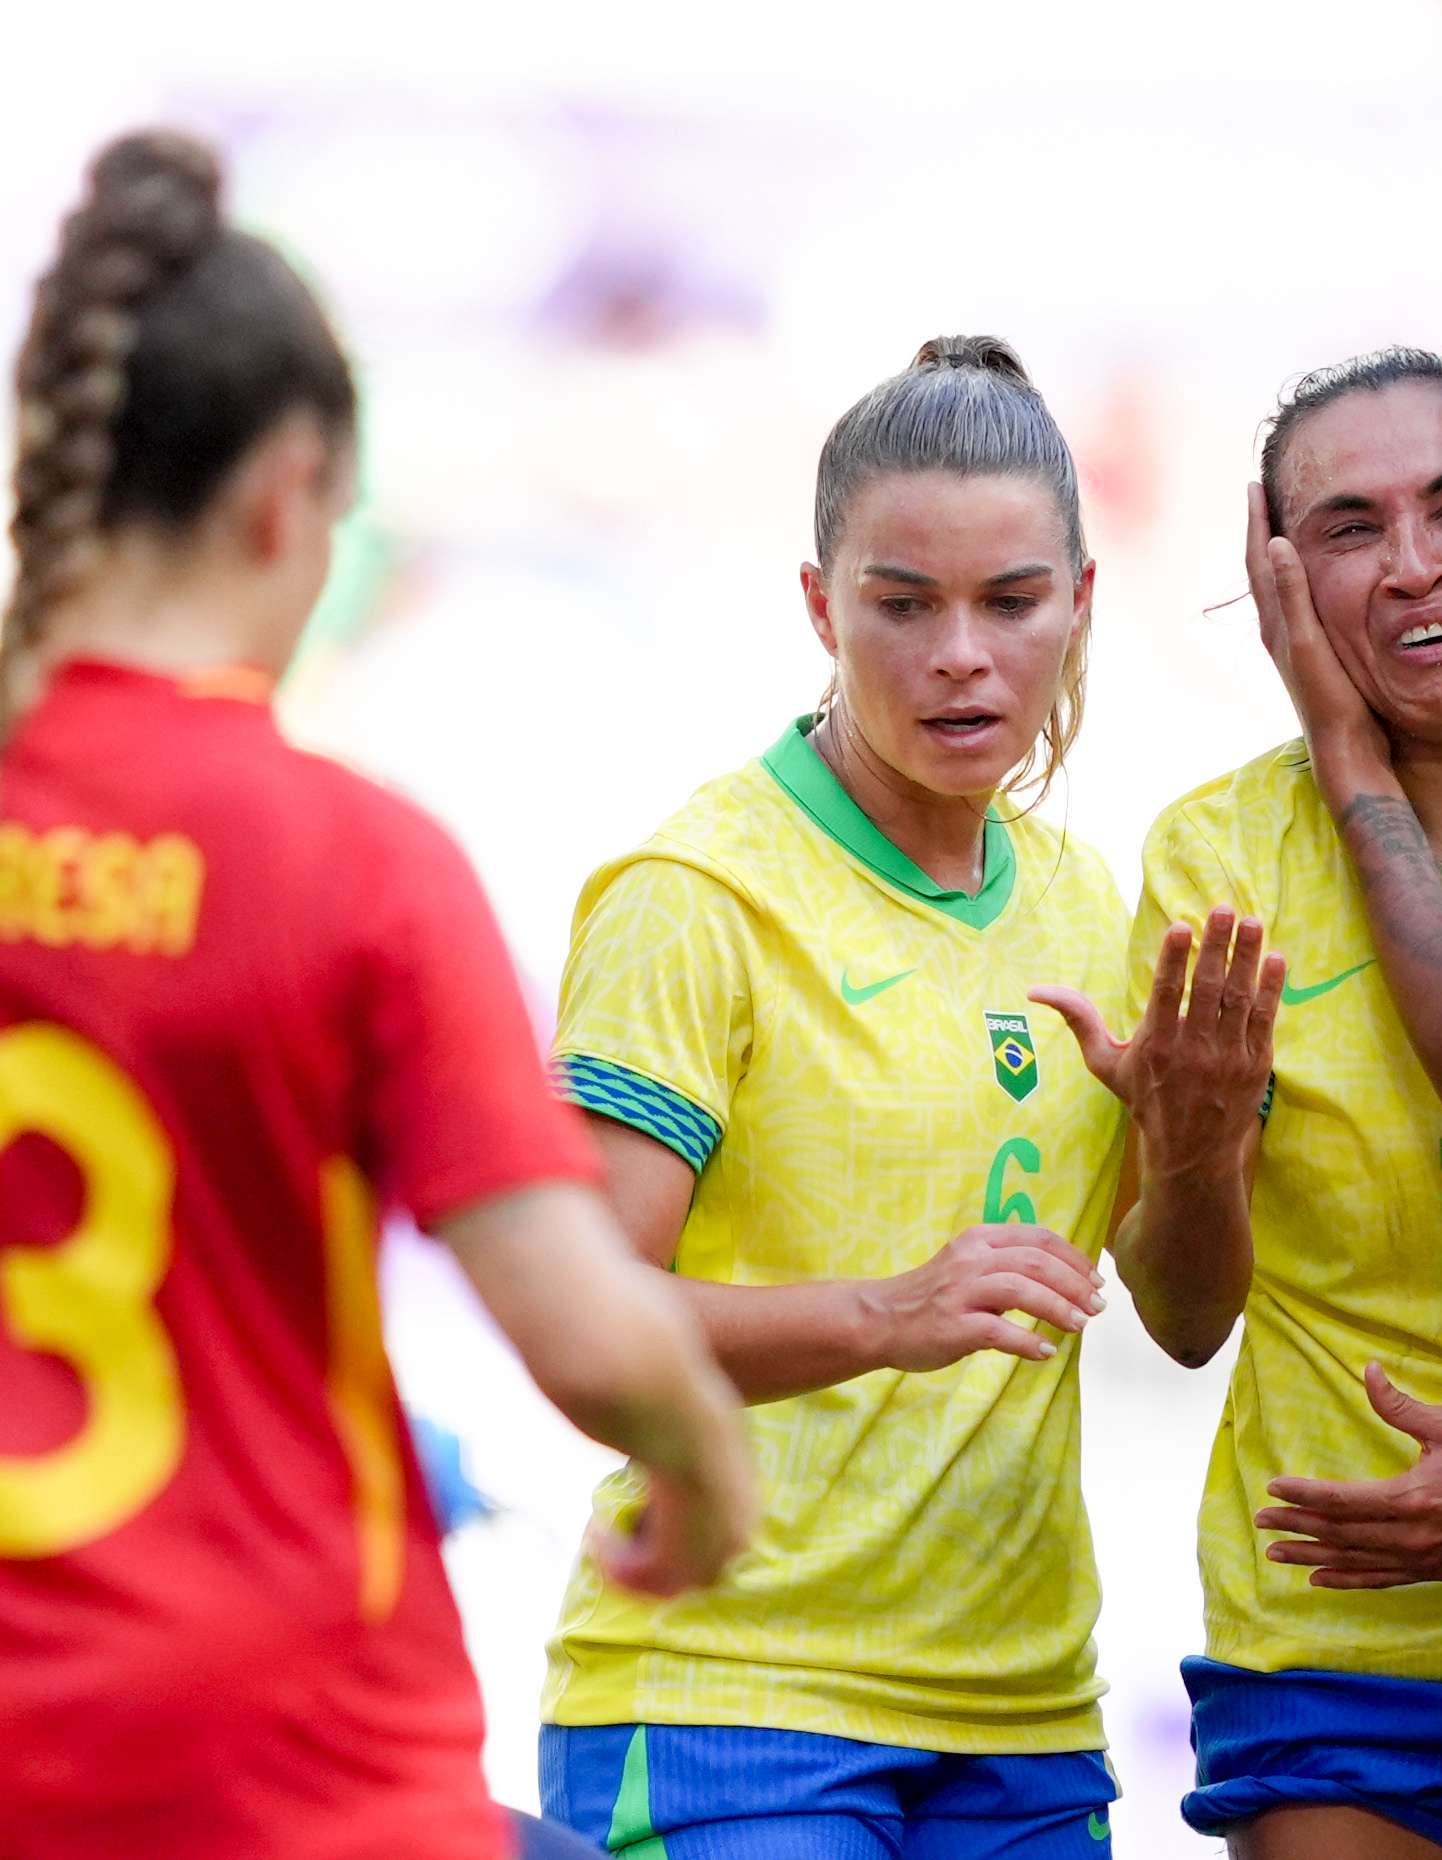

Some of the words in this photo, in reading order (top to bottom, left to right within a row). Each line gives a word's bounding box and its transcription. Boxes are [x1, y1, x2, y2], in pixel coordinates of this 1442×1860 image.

[986, 1018, 1028, 1033] BRASIL
[982, 1136, 1041, 1225] 6
[0, 1018, 188, 1560] 3
